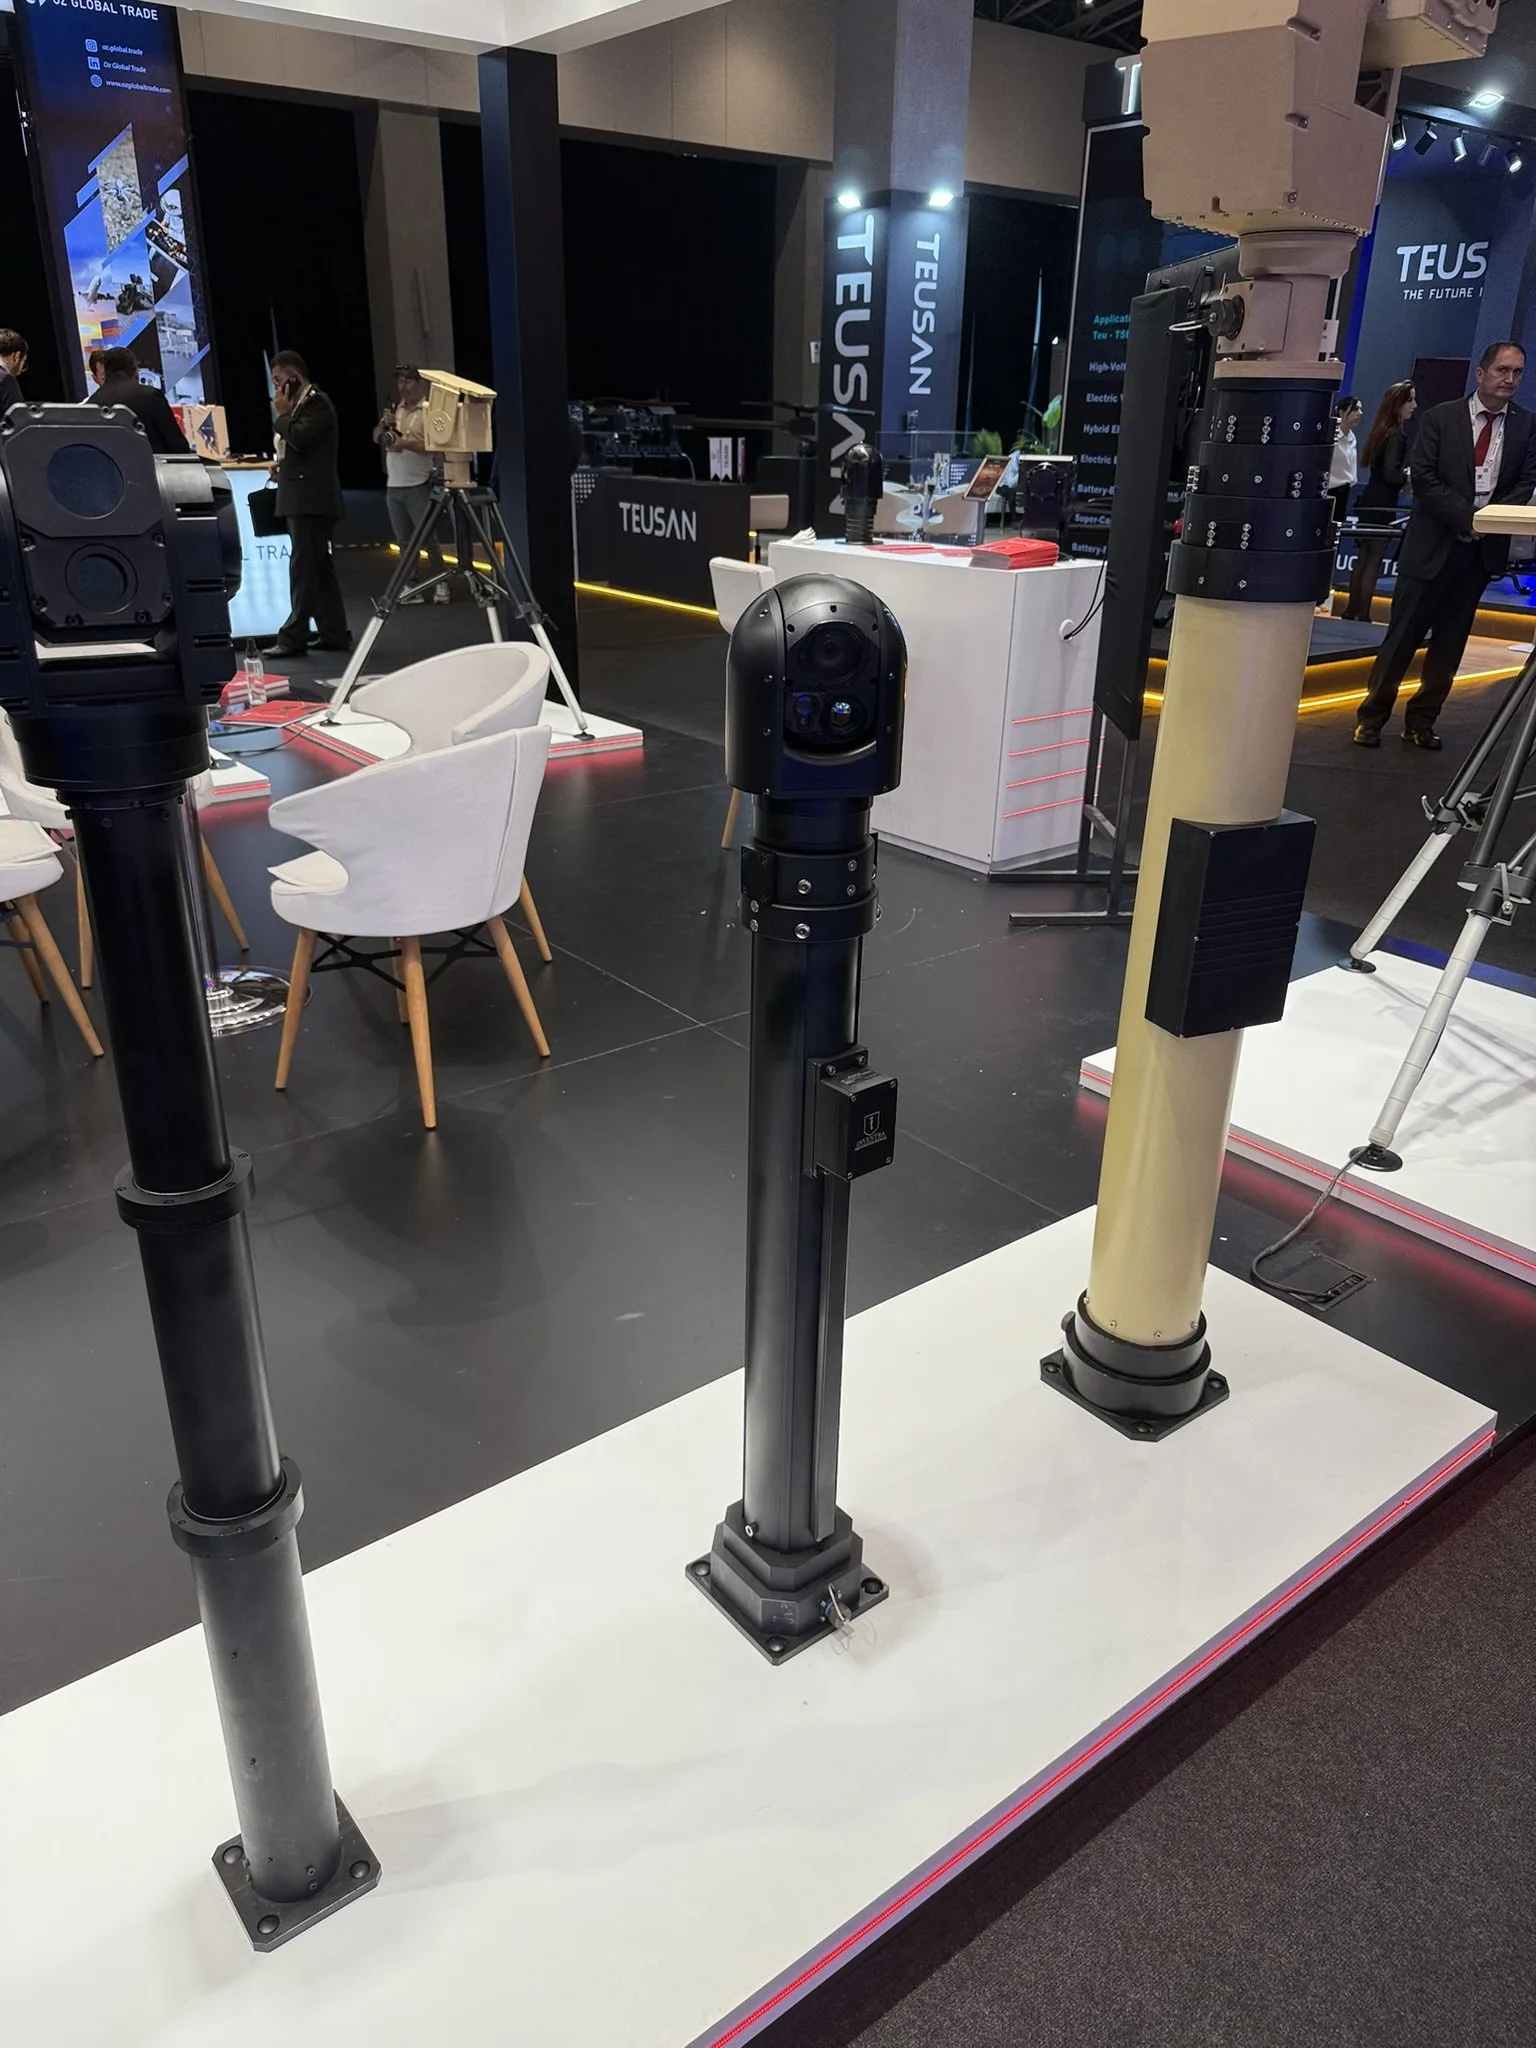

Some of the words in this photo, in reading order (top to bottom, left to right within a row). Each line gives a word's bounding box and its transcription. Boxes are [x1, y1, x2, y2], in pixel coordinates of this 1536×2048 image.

[71, 0, 118, 14] GLOBAL
[120, 4, 159, 20] TRADE
[1396, 241, 1489, 283] TEUS
[1403, 289, 1423, 301] THE
[1429, 287, 1474, 300] FUTURE
[909, 233, 940, 395] TEUSAN
[829, 214, 874, 515] TEUSA
[1086, 393, 1118, 403] Electric
[1083, 424, 1110, 435] Hybrid
[1080, 454, 1112, 465] Electric
[619, 501, 697, 542] TEUSAN
